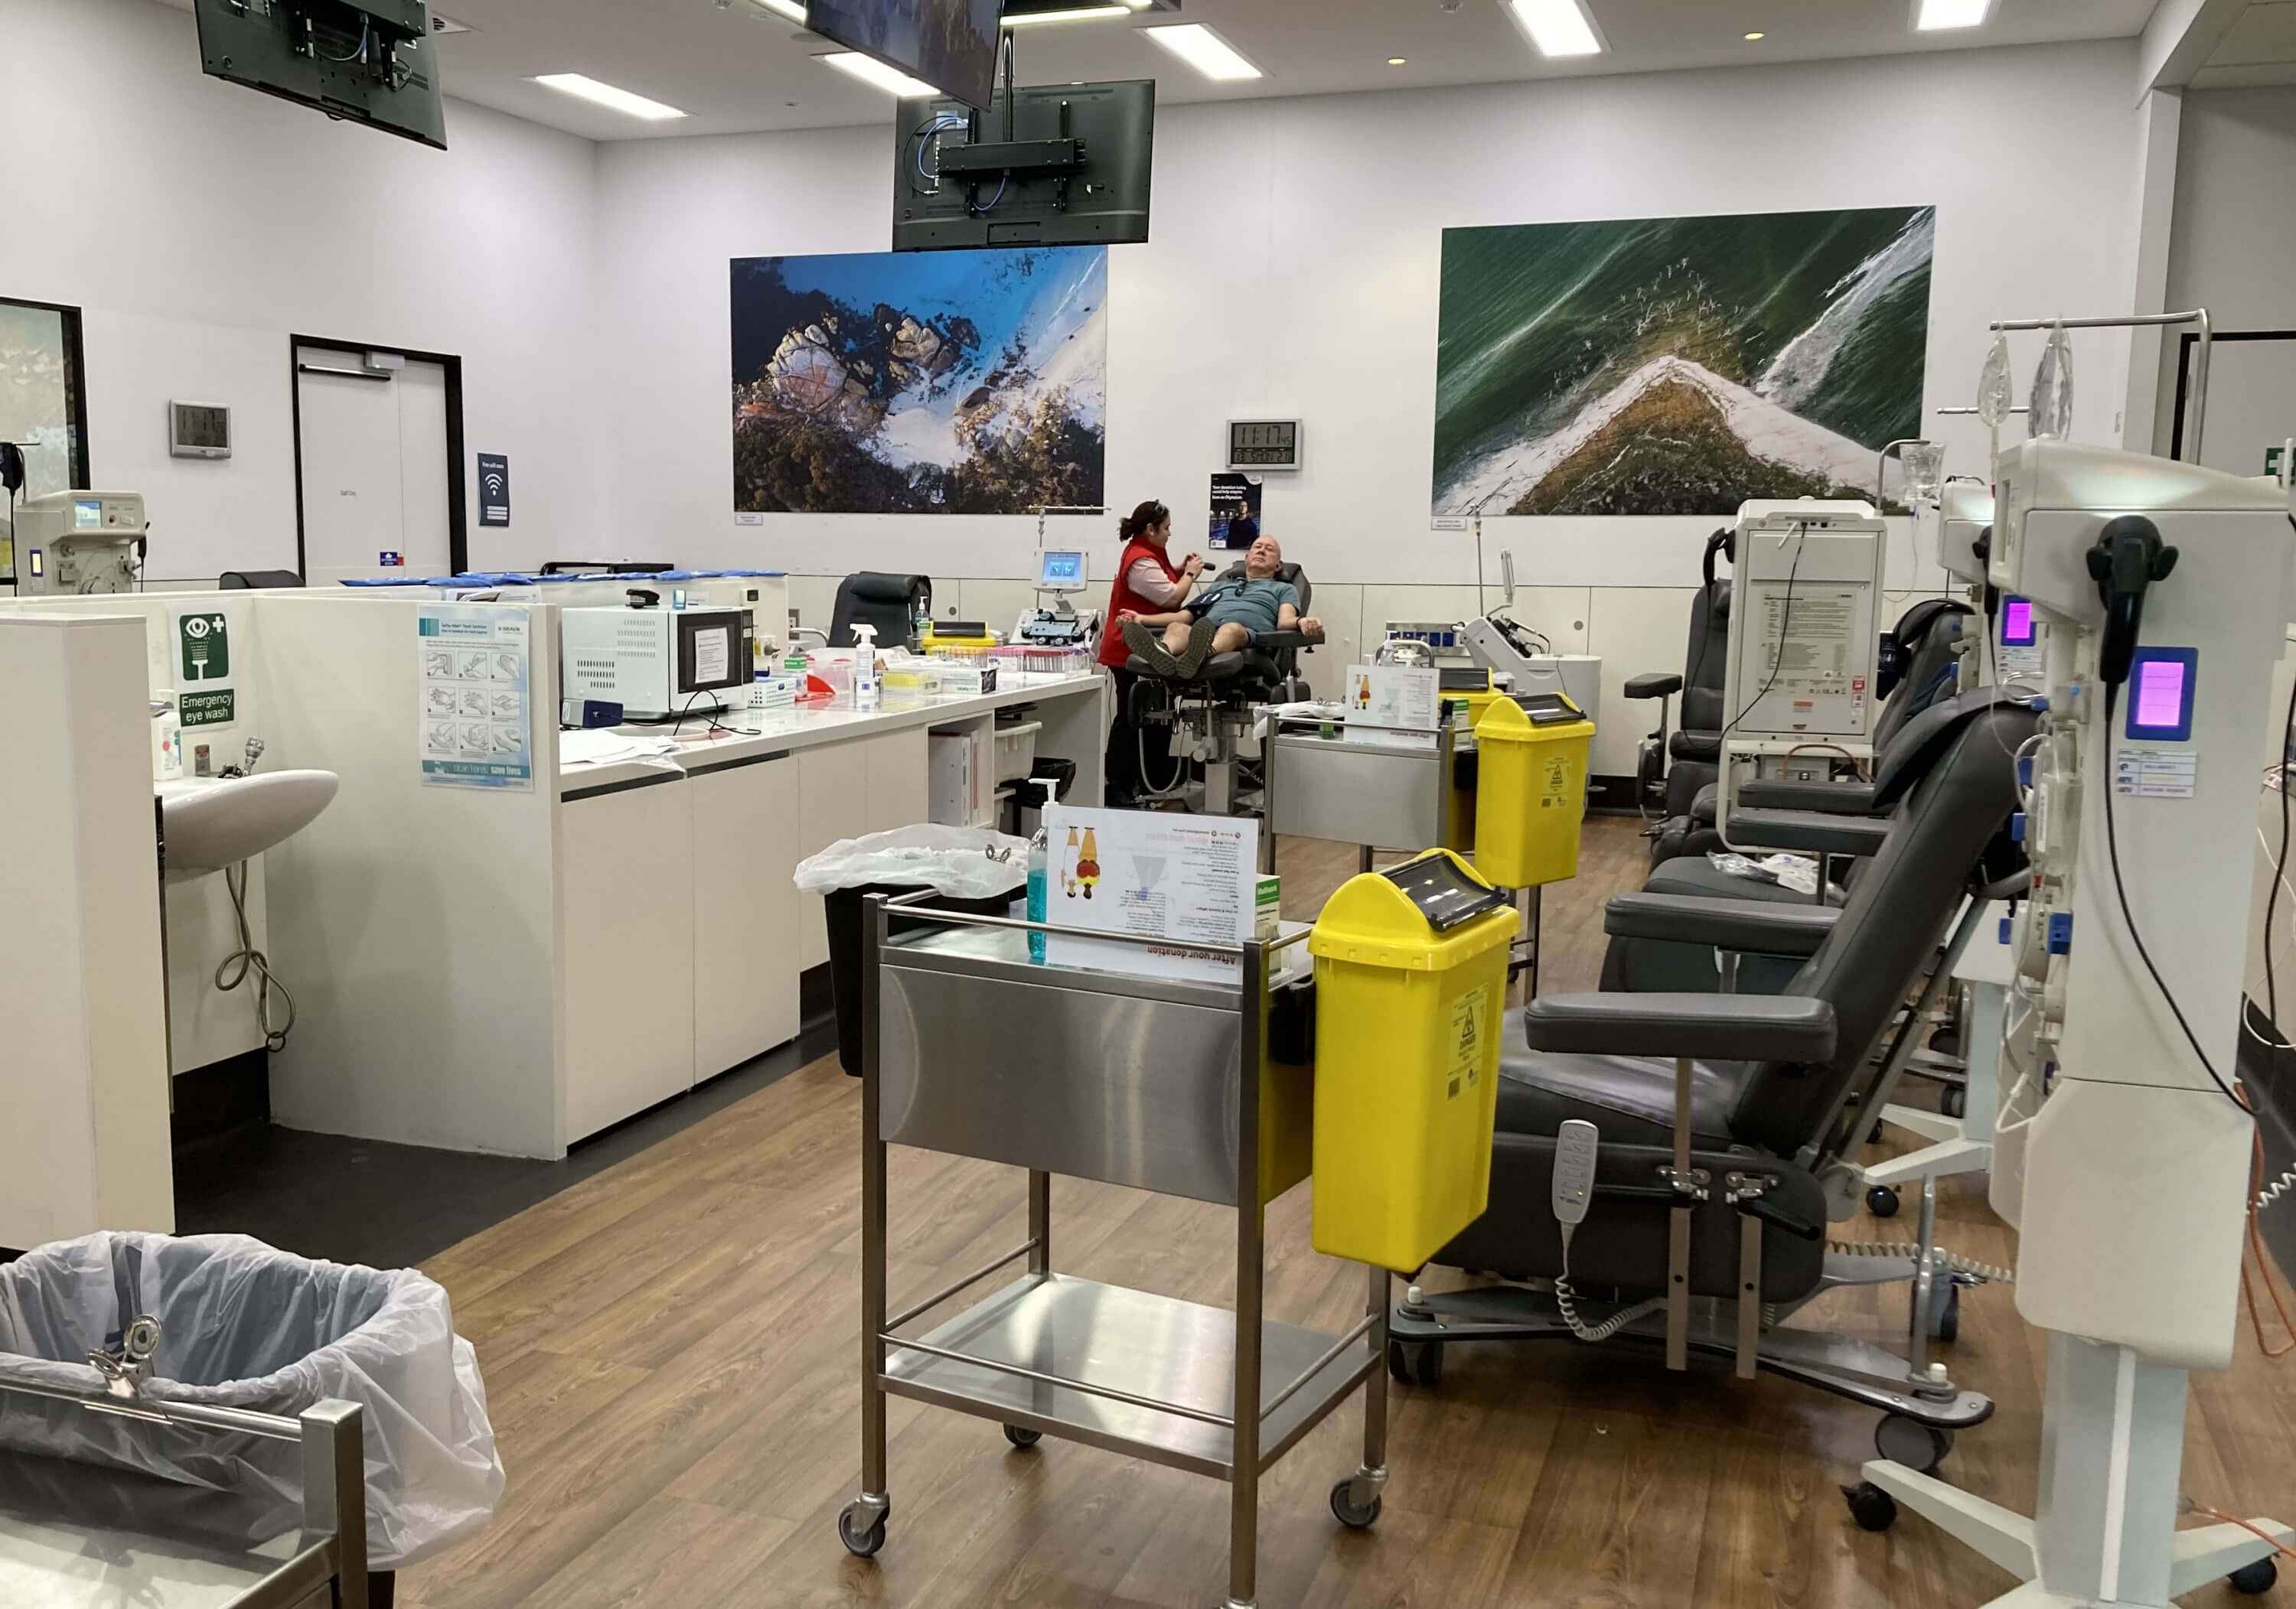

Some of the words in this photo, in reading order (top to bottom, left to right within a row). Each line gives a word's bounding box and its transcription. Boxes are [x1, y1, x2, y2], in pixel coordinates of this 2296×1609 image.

[1241, 425, 1280, 445] 11:17
[181, 695, 233, 708] Emergency
[186, 712, 203, 724] eye
[205, 707, 228, 720] wash
[1147, 946, 1187, 959] donation
[1188, 951, 1210, 961] your
[1212, 954, 1237, 966] After
